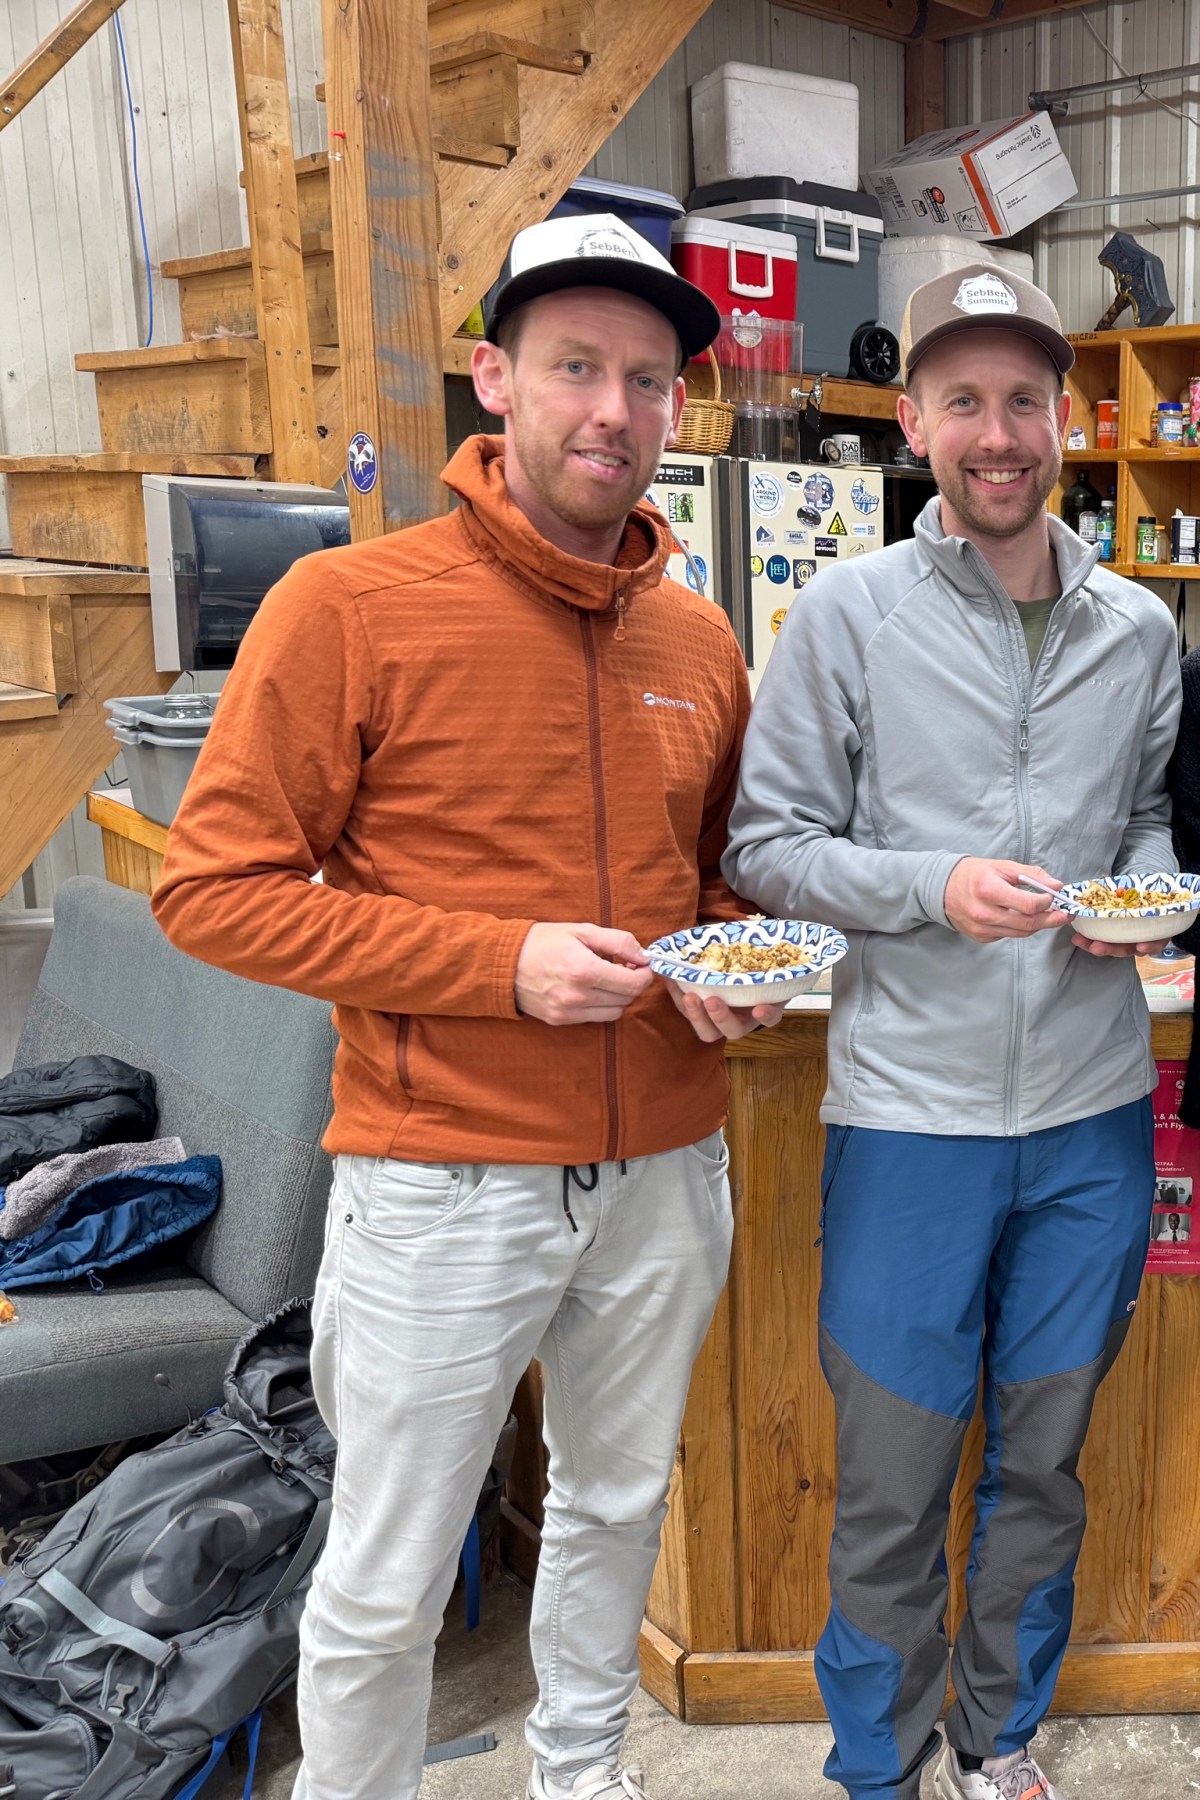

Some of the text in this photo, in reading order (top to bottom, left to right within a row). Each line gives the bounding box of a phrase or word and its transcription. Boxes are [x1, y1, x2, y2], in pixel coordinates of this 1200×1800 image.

[589, 241, 635, 259] SebBen
[966, 289, 1008, 298] SebBen
[967, 298, 1010, 306] Summits
[841, 444, 859, 452] DAD
[668, 493, 676, 522] uvex
[655, 697, 696, 711] MONTANE
[1170, 1122, 1185, 1131] Fly.
